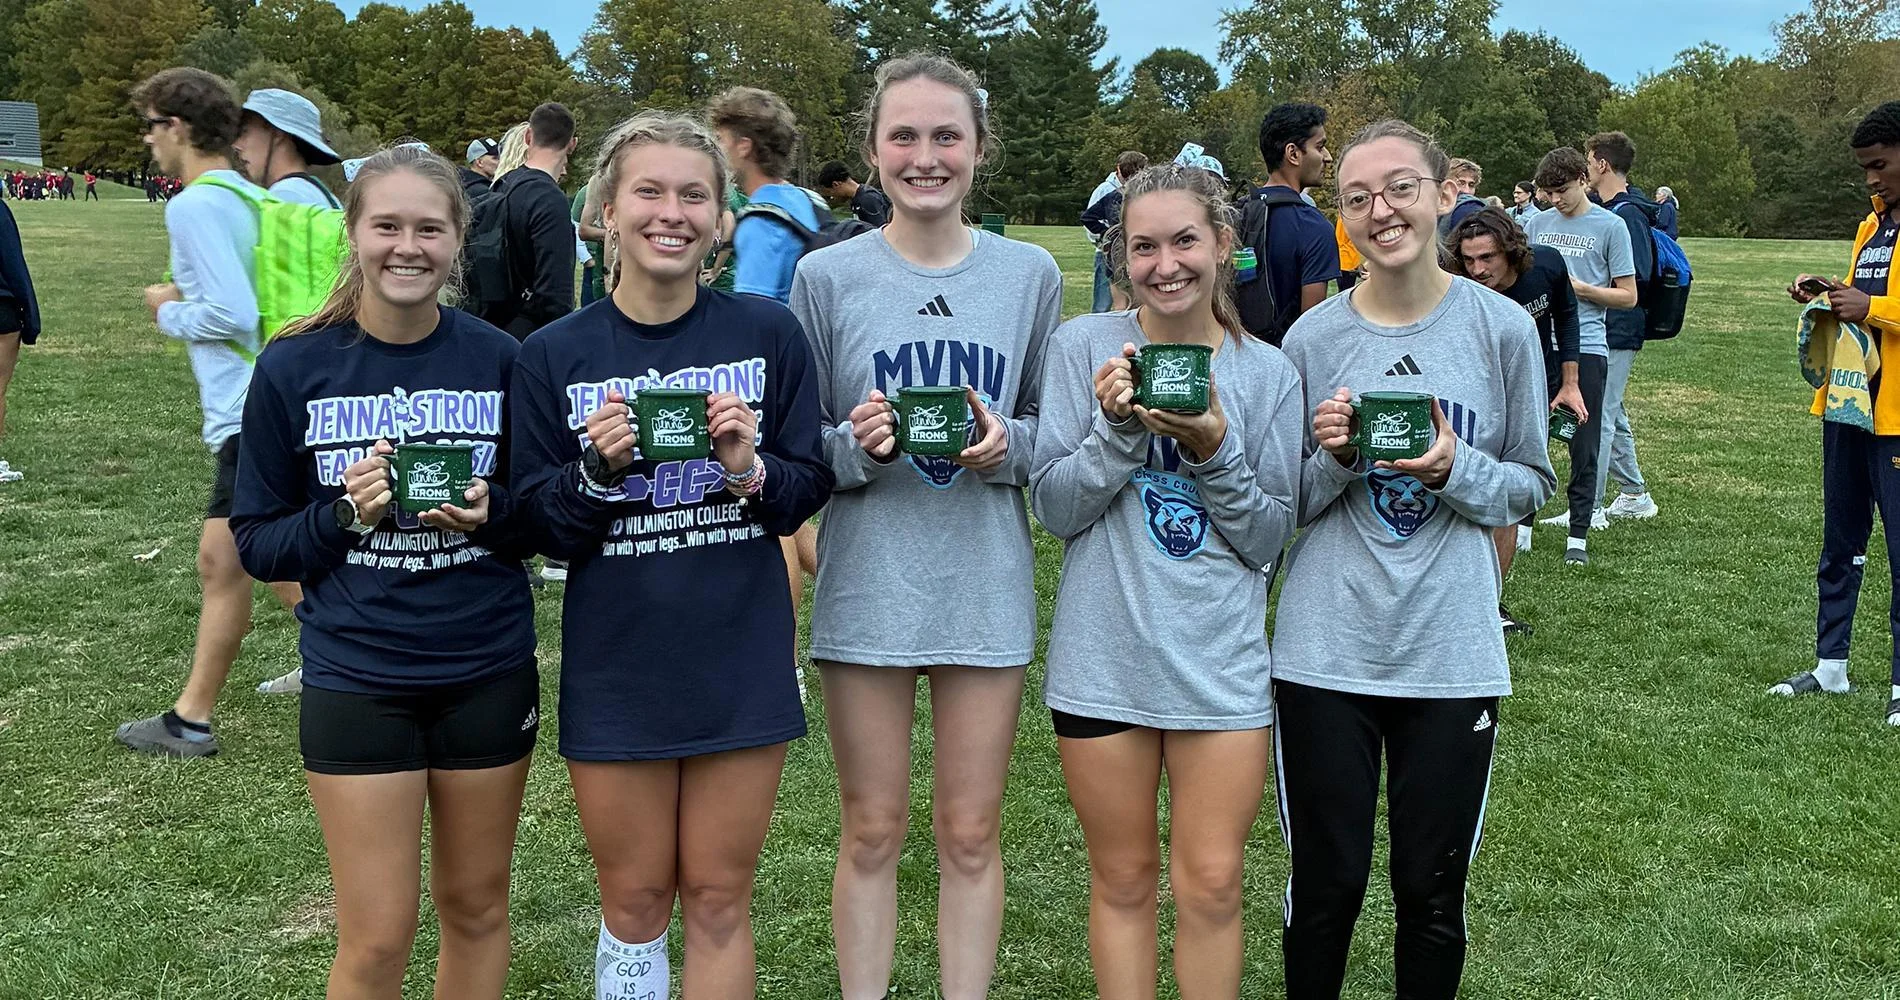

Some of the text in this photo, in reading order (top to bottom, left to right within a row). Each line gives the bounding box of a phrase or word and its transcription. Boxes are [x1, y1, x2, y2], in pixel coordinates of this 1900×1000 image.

[872, 340, 1006, 401] MVNU
[1151, 383, 1191, 392] STRONG
[305, 387, 504, 446] JENNA STRON
[653, 435, 694, 444] STRONG
[909, 431, 948, 440] STRONG
[1370, 437, 1411, 446] STRONG
[408, 488, 451, 498] STRONG
[625, 509, 694, 536] WILMINGTON
[696, 503, 742, 526] COLLEGE
[370, 531, 438, 552] WILMINGTON
[616, 539, 634, 556] with
[635, 539, 658, 558] your
[706, 527, 727, 544] with
[727, 525, 750, 545] your
[378, 554, 404, 570] your
[616, 961, 652, 977] GOD
[623, 982, 636, 995] IS
